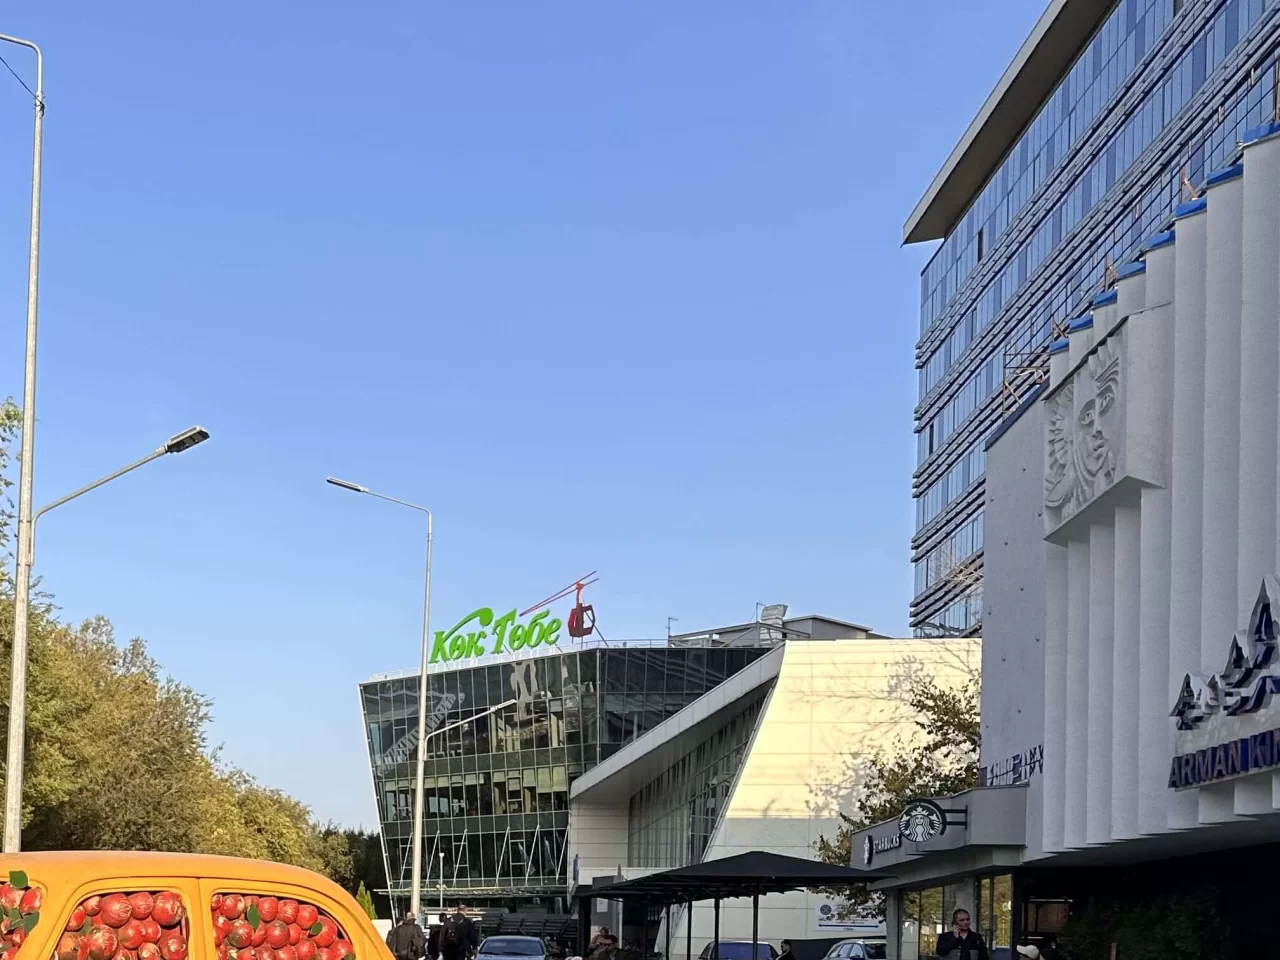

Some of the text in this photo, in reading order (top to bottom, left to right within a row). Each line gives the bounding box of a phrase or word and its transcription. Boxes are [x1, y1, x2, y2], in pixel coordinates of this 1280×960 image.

[429, 608, 562, 663] Көк Төбе
[1168, 738, 1248, 788] ARMAN
